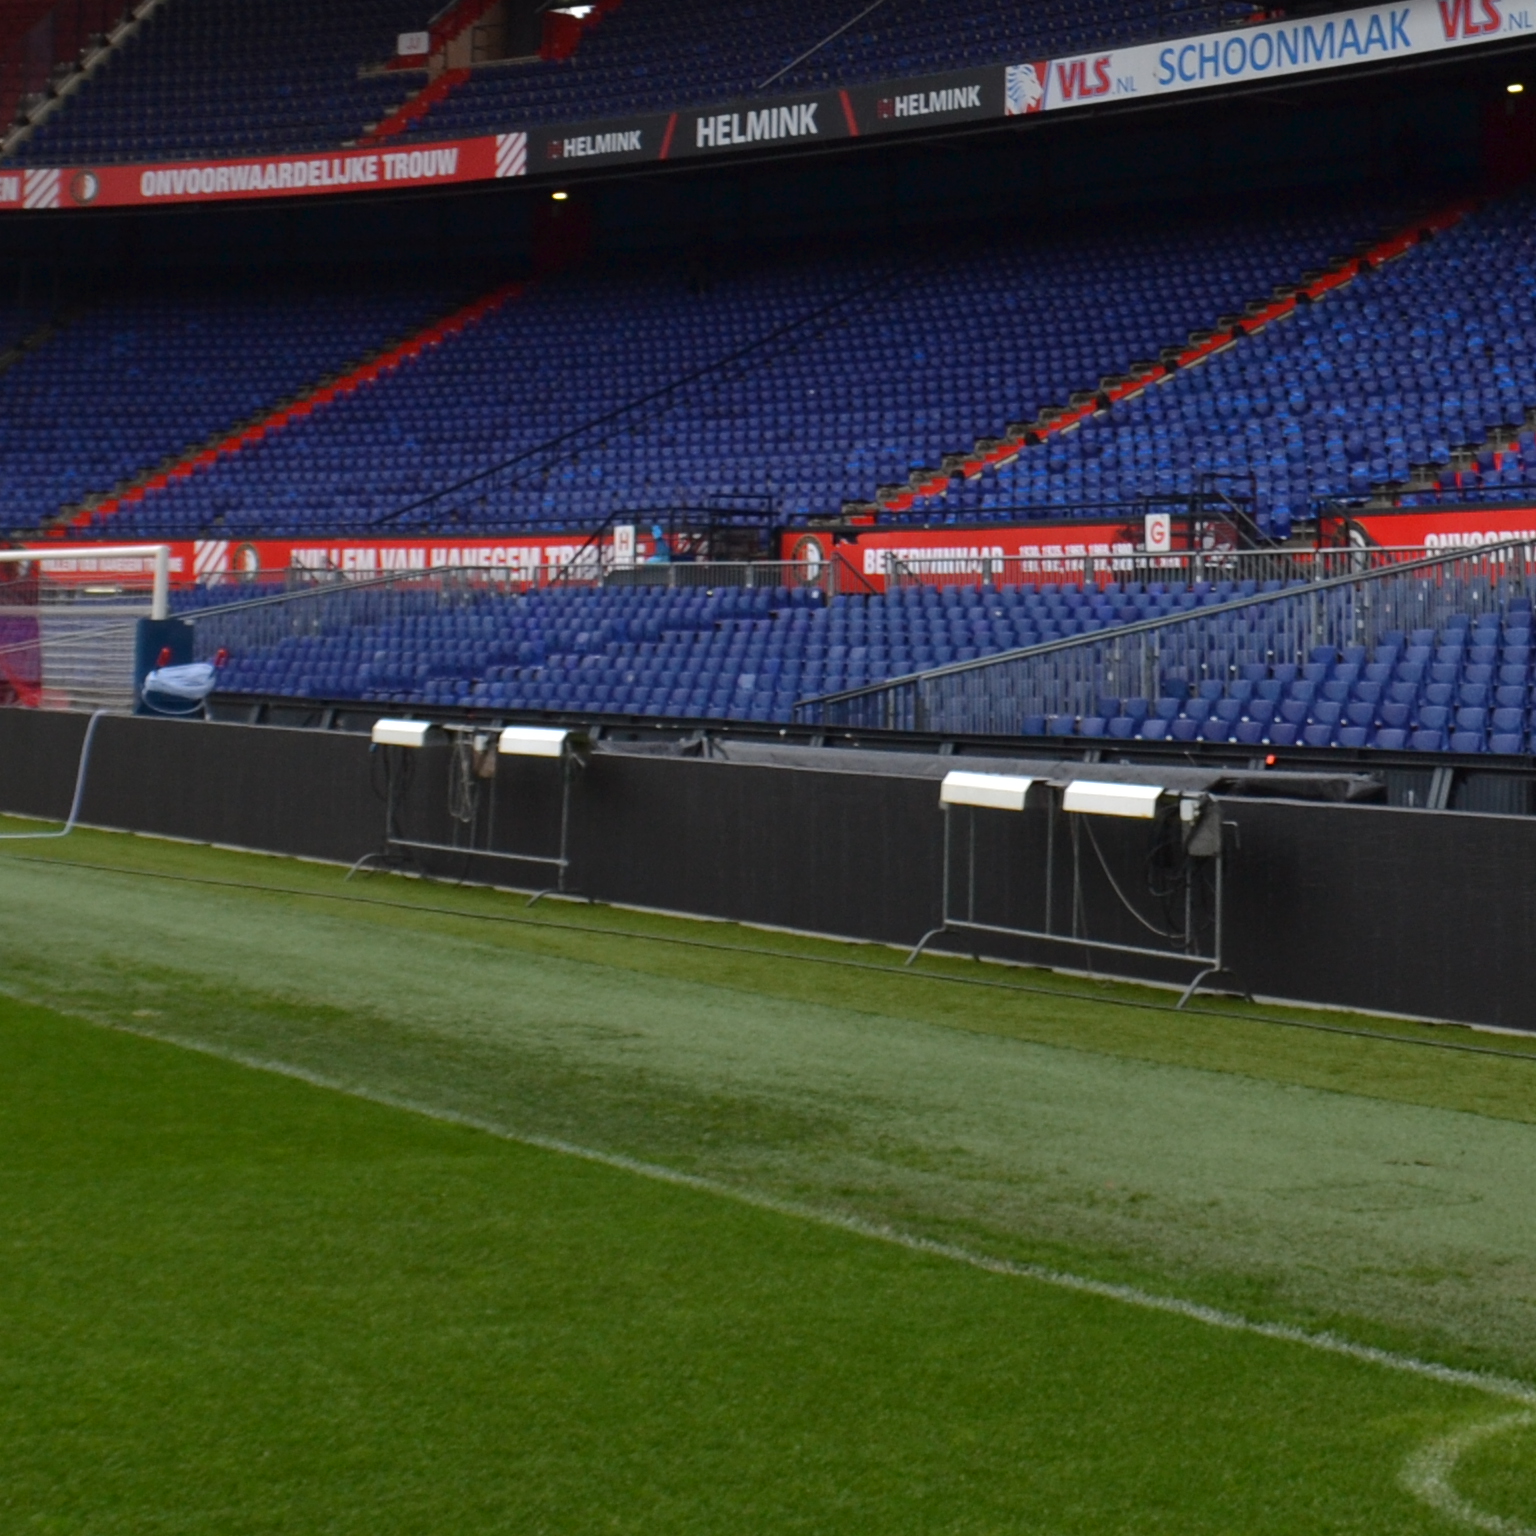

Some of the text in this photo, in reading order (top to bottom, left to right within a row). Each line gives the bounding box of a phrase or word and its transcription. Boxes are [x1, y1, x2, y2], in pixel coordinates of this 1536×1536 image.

[1158, 7, 1412, 87] SCHOONMAAK
[894, 85, 981, 118] HELMINK
[696, 102, 818, 149] HELMINK
[564, 129, 642, 159] HELMINK
[140, 147, 460, 197] ONVOORWAARDELIJKE TROUW
[619, 531, 629, 552] H
[1150, 520, 1166, 545] G
